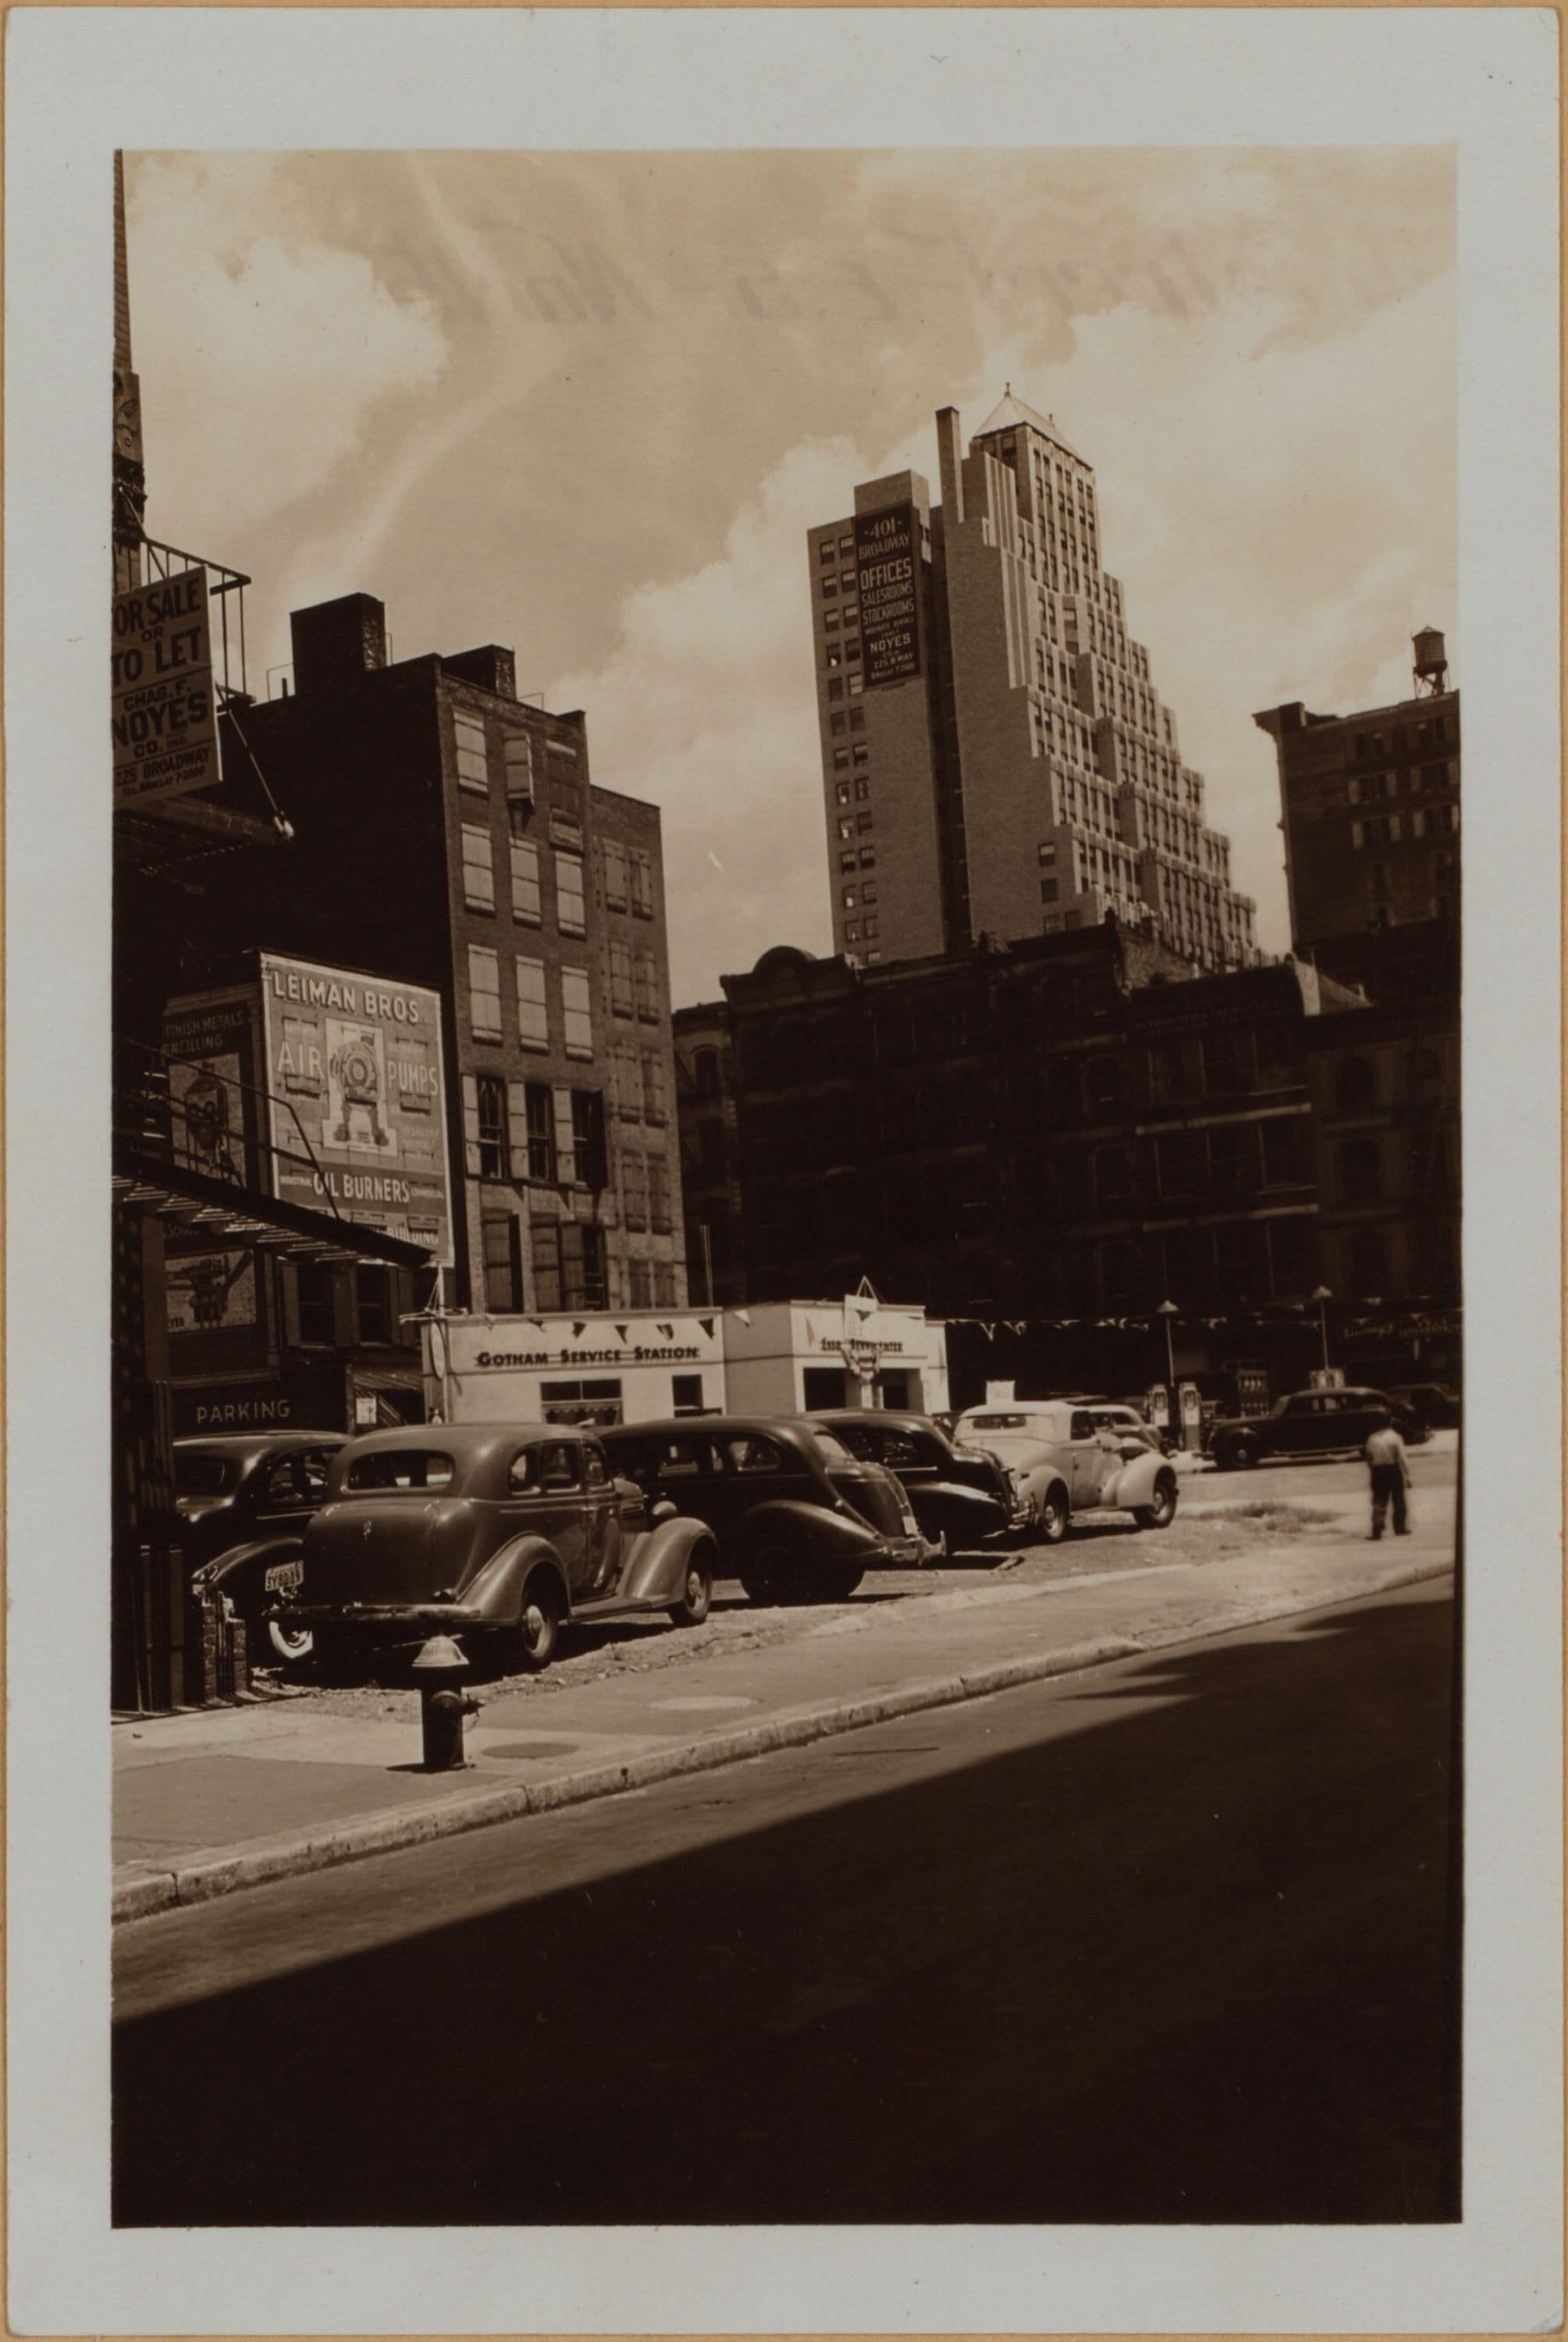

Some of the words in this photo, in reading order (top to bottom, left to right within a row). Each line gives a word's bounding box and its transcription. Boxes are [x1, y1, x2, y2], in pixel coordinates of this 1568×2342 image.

[869, 517, 895, 538] 401
[859, 531, 911, 561] BROADWAY
[860, 557, 912, 591] OFFICES
[147, 578, 201, 625] SALE
[862, 579, 913, 607] SALESROOMS
[862, 597, 915, 625] STOCKROOMS
[141, 626, 164, 642] OR
[870, 632, 912, 655] NOYES
[112, 649, 144, 687] TO
[155, 626, 201, 674] LET
[112, 691, 208, 749] NOYES
[142, 746, 211, 779] BROADWAY
[274, 971, 356, 1011] LEIMAN
[203, 1011, 244, 1030] METALS
[277, 1041, 325, 1080] AIR
[387, 1059, 439, 1096] PUMPS
[343, 1174, 410, 1203] BURNERS
[476, 1351, 547, 1367] GOTHAM
[560, 1349, 621, 1363] SERVICE
[634, 1346, 699, 1360] STATION
[197, 1399, 291, 1424] PARKING
